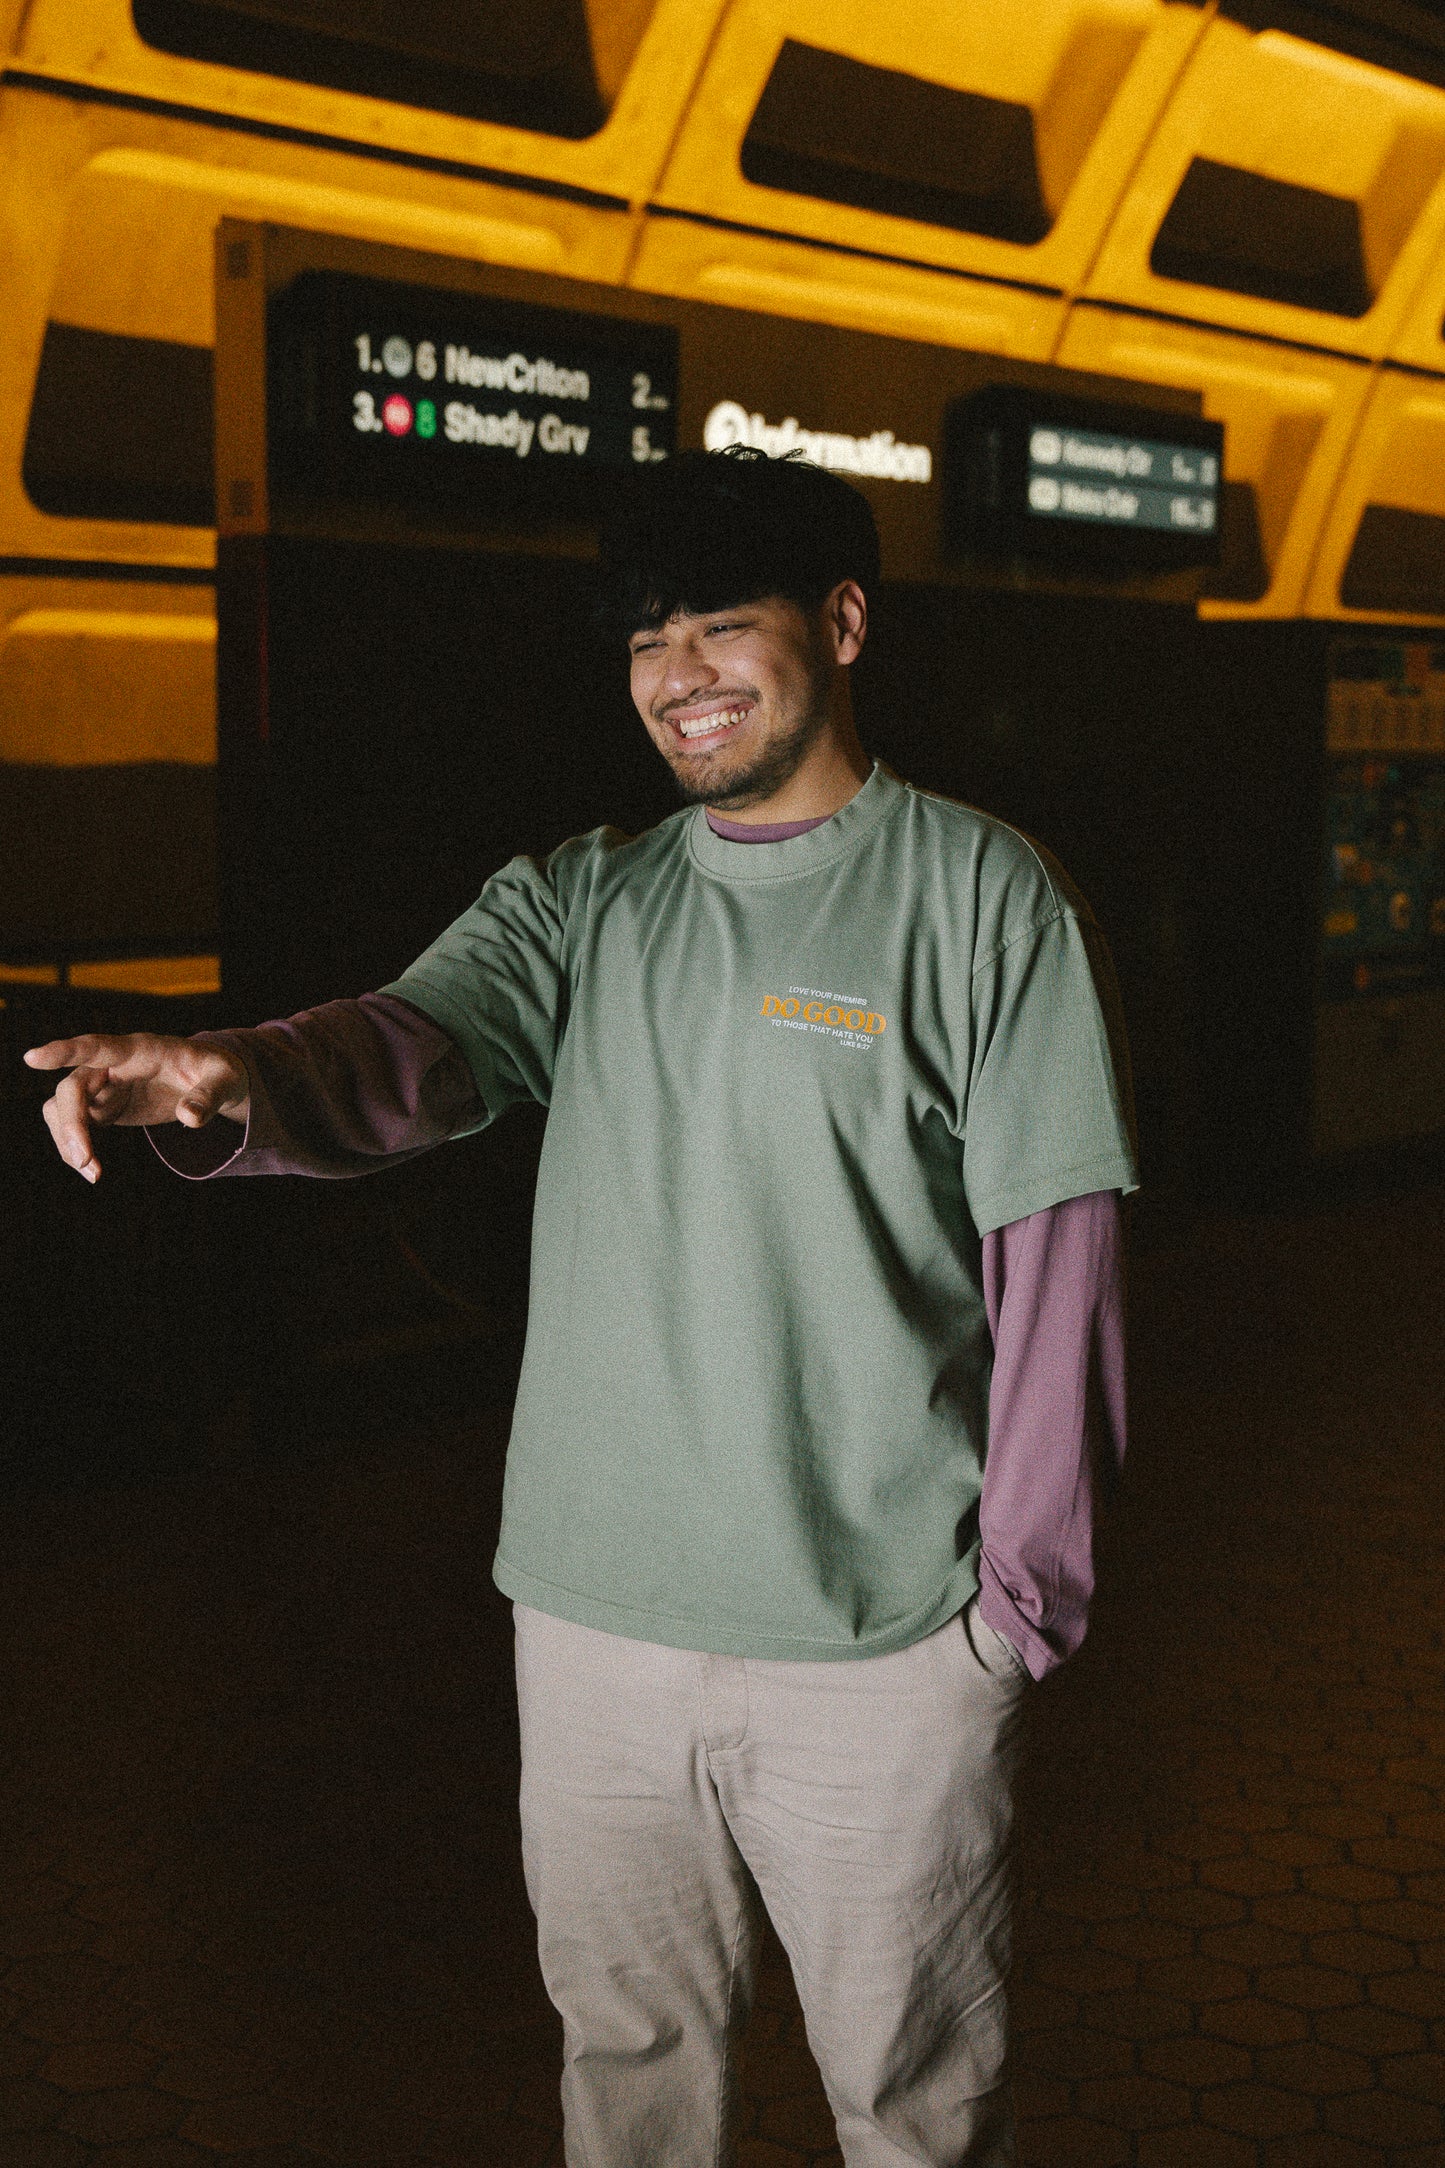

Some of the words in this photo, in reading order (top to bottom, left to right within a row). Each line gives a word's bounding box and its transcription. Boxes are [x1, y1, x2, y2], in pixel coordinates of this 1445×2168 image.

[444, 401, 535, 458] Shady
[538, 413, 590, 455] Grv
[788, 985, 809, 995] LOVE
[810, 990, 832, 1000] YOUR
[833, 994, 868, 1006] ENEMIES
[760, 995, 800, 1018] DO
[803, 1001, 887, 1035] GOOD
[771, 1019, 782, 1027] TO
[783, 1020, 808, 1031] THOSE
[809, 1025, 831, 1035] THAT
[831, 1029, 854, 1040] HATE
[855, 1033, 874, 1044] YOU
[840, 1039, 856, 1048] LUKE
